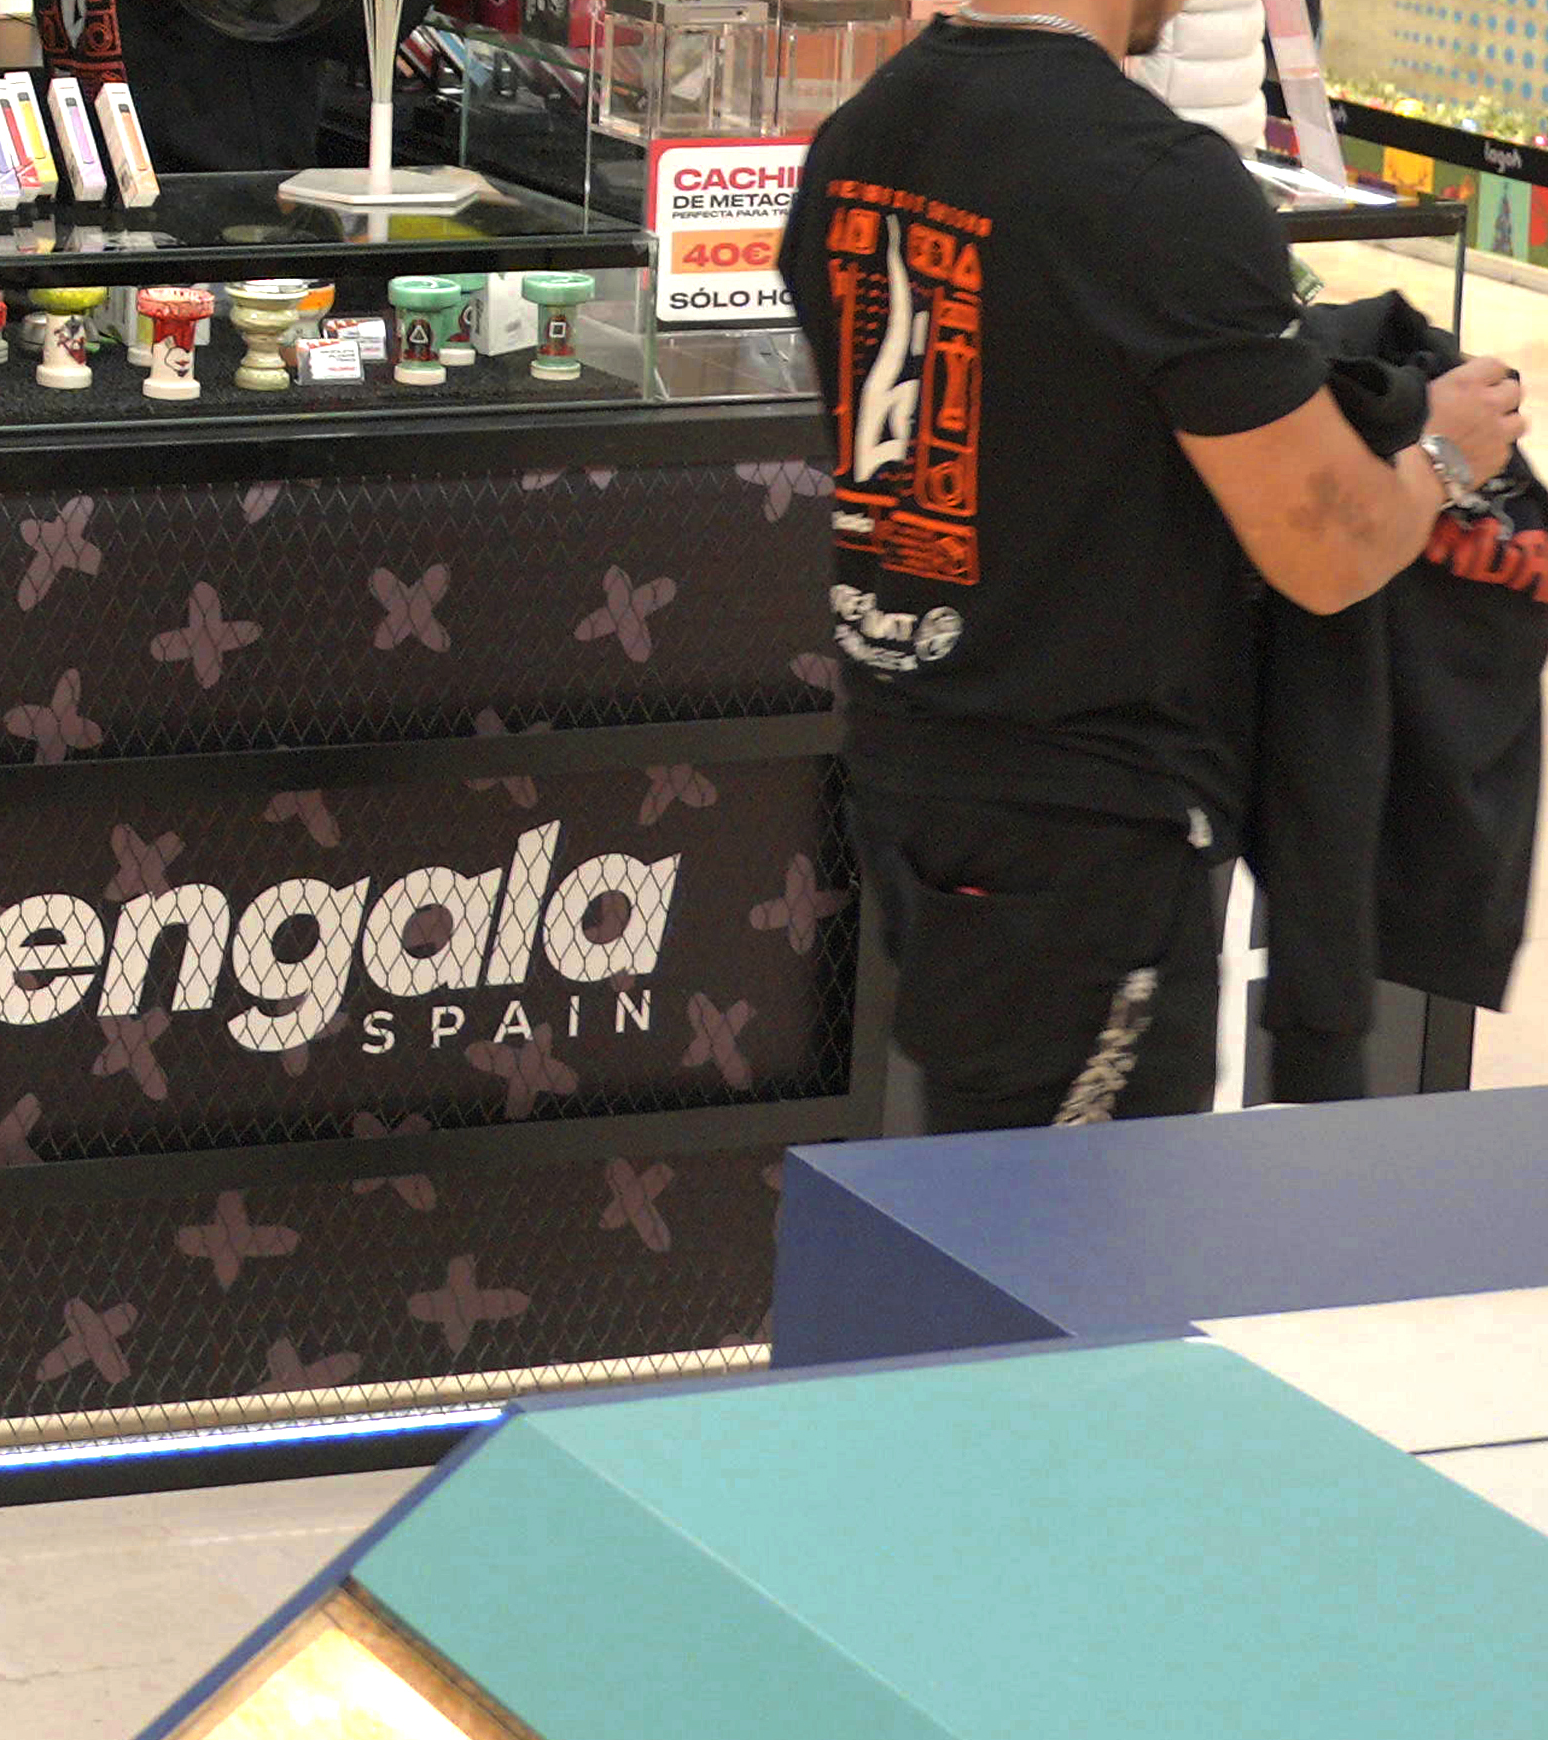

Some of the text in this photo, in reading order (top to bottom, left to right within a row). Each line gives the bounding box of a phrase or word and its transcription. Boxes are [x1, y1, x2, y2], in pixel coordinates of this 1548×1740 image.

[672, 194, 705, 209] DE
[671, 210, 734, 220] PERFECTA
[735, 209, 769, 218] PARA
[681, 241, 773, 268] 40€
[669, 287, 751, 310] SÓLO
[360, 987, 654, 1056] SPAIN
